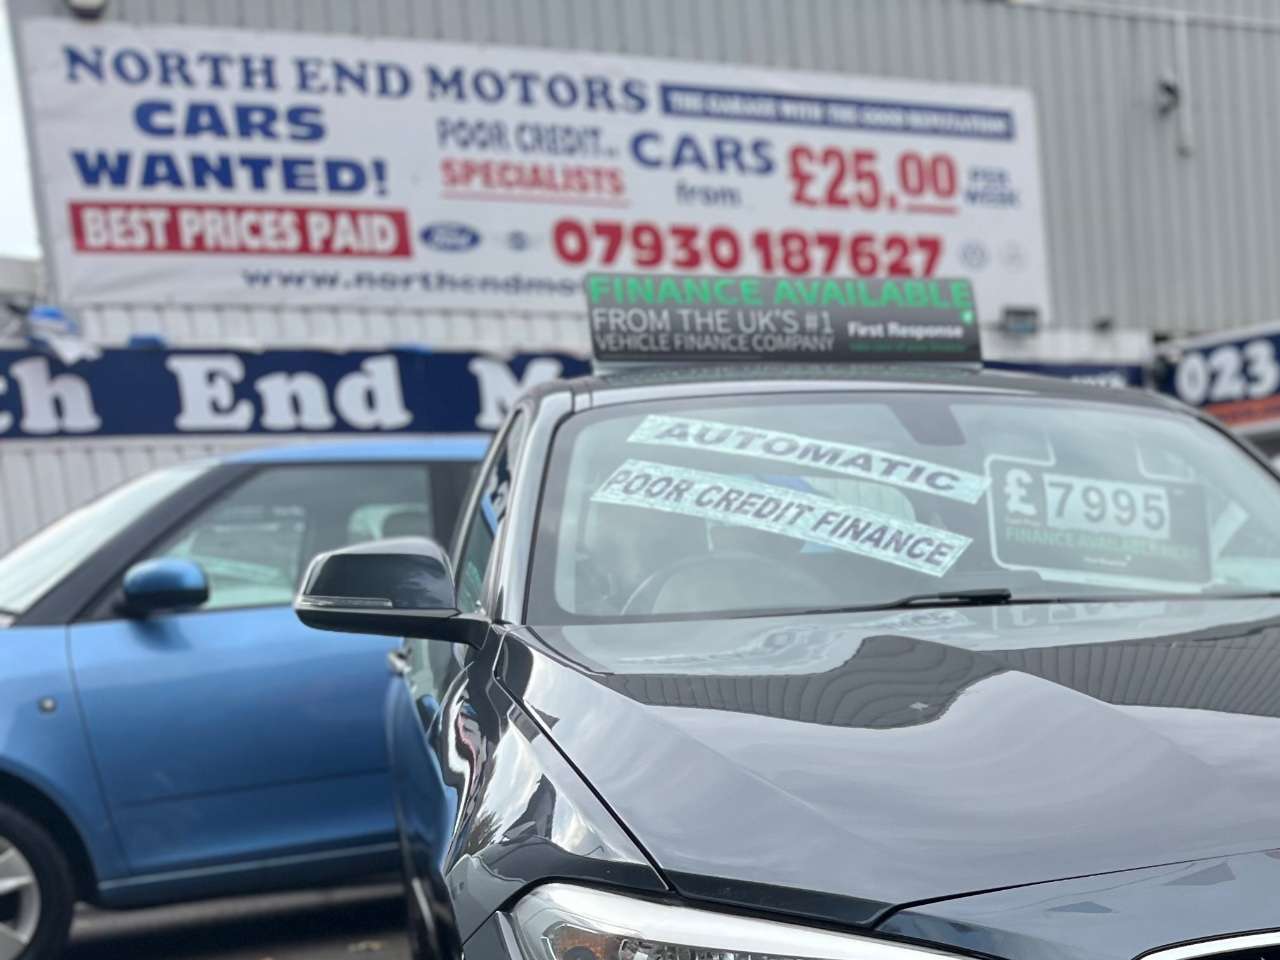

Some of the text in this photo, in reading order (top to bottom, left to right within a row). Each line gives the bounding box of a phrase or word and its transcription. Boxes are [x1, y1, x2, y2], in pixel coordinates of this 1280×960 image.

[62, 45, 649, 113] NORTH END MOTORS
[133, 98, 328, 142] CARS
[437, 117, 509, 151] POOR
[70, 149, 391, 198] WANTED!
[440, 156, 626, 195] SPECIALISTS
[628, 131, 778, 176] CARS
[676, 179, 743, 208] from
[788, 143, 960, 212] £25.00
[80, 207, 399, 255] BEST PRICES PAID
[590, 276, 976, 309] FINANCE AVAILABLE
[591, 307, 835, 335] FROM THE UK'S #1
[596, 333, 672, 352] VEHICLE
[674, 334, 750, 353] FINANCE
[752, 334, 836, 353] COMPANY
[847, 321, 963, 341] First Response
[165, 353, 413, 432] End
[654, 419, 964, 493] AUTOMATIC
[601, 468, 959, 568] POOR CREDIT FINANCE
